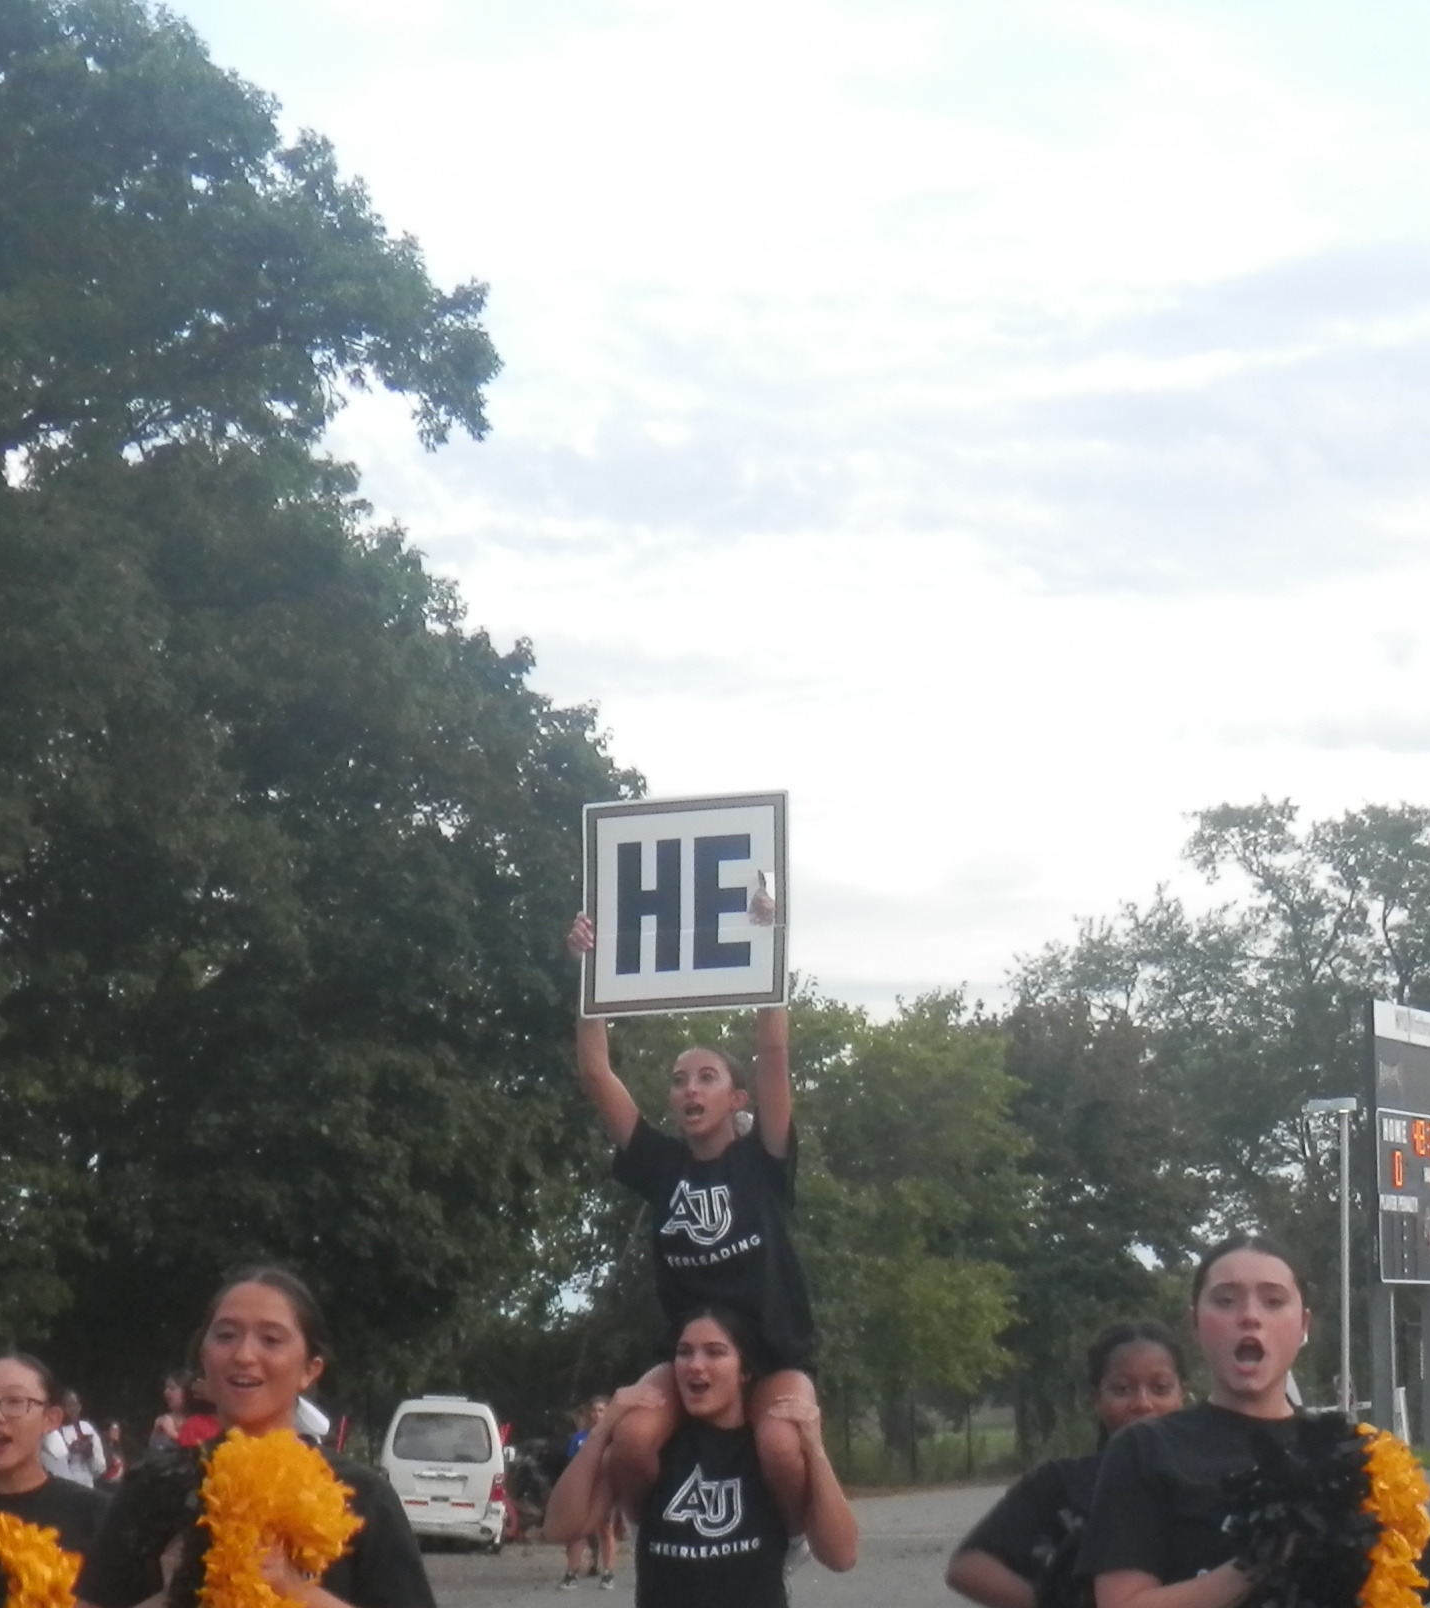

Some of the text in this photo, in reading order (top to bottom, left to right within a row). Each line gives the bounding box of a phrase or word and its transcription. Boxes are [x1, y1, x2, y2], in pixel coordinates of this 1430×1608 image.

[615, 833, 751, 975] HE
[660, 1179, 733, 1246] AU
[664, 1234, 761, 1268] EERLEADING
[662, 1463, 742, 1537] AU
